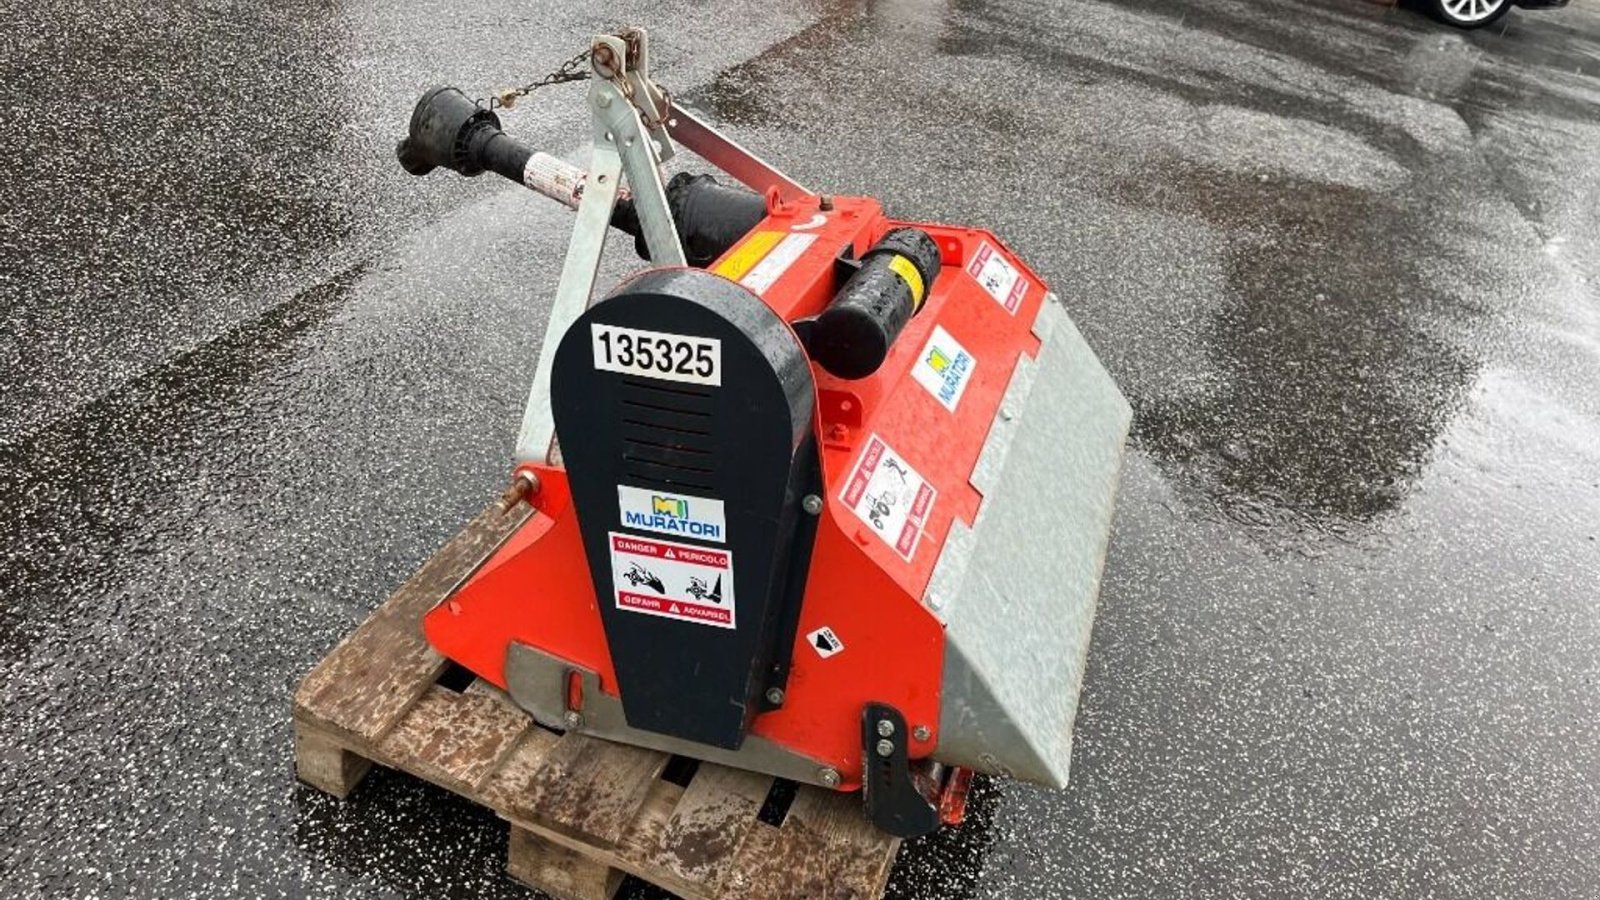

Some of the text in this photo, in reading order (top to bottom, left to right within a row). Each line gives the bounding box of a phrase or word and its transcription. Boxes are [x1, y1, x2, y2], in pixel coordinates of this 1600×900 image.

[599, 331, 714, 377] 135325
[626, 511, 720, 538] MURATORI
[617, 541, 658, 554] DANGER
